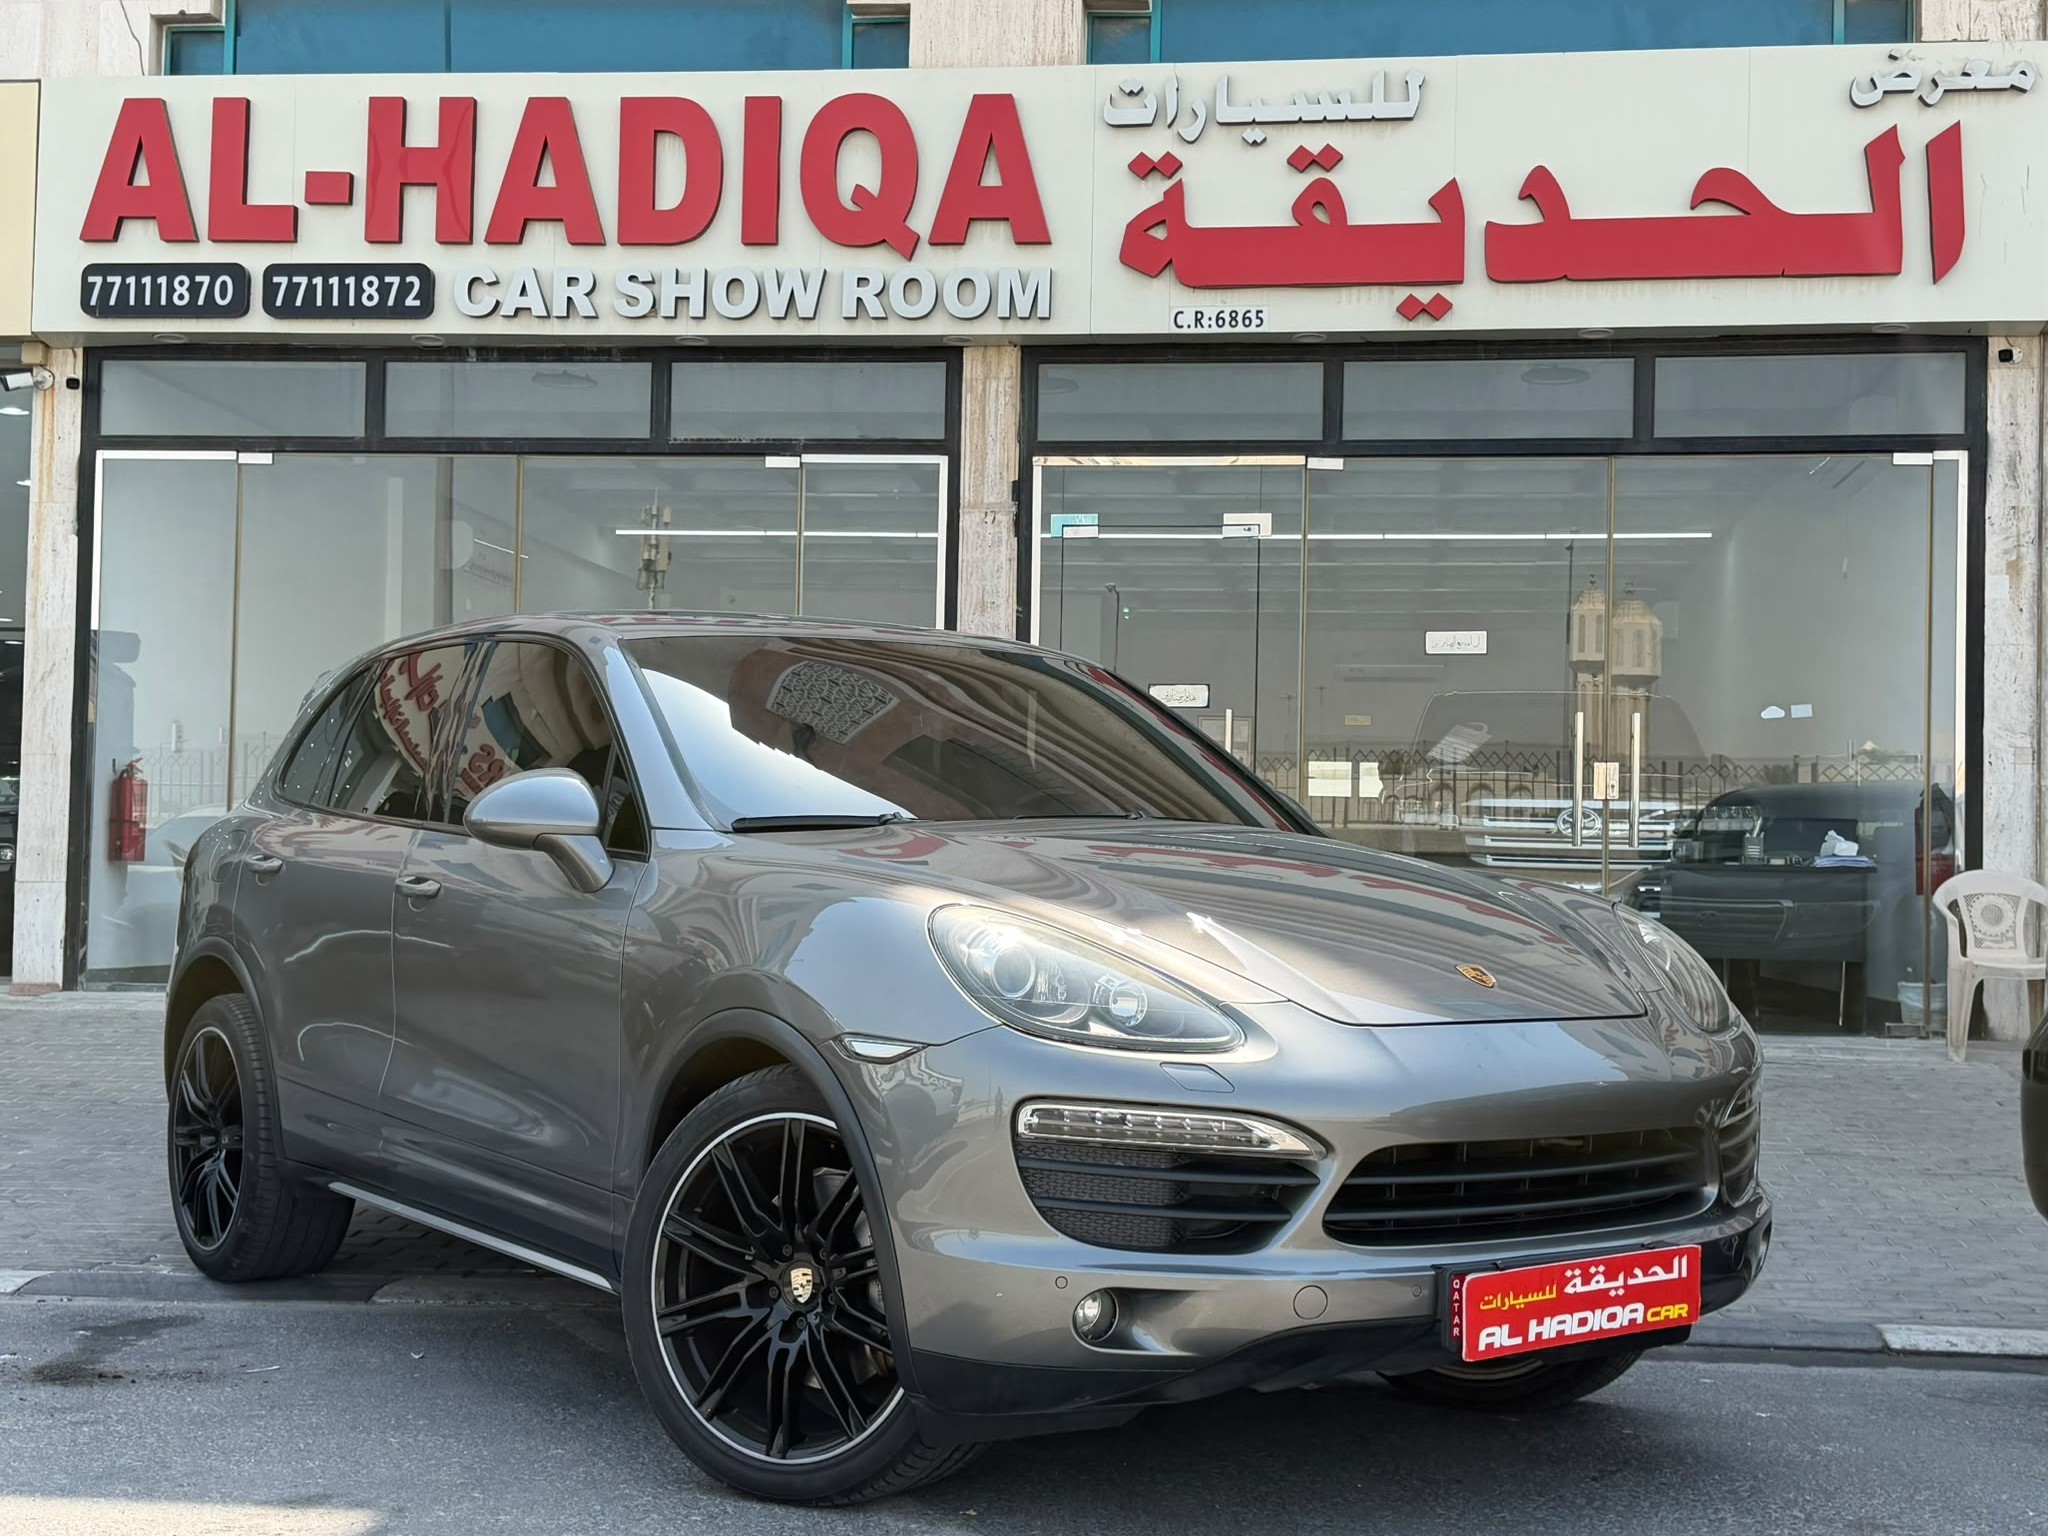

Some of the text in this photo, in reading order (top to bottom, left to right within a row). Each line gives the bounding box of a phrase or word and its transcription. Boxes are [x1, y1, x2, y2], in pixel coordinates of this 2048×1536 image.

[1850, 49, 2038, 108] معرض
[1103, 71, 1425, 145] للسيارات
[80, 93, 1052, 260] AL-HADIQA
[1118, 120, 1966, 322] الحديقة
[87, 275, 234, 306] 77111870
[272, 275, 421, 307] 77111872
[454, 267, 1052, 320] CAR SHOW ROOM
[1173, 309, 1264, 329] C.R:6865
[1452, 1278, 1461, 1338] QATAR
[1479, 1254, 1688, 1310] الحديقة للسيارات
[1478, 1302, 1689, 1352] AL HADIQA CAR
